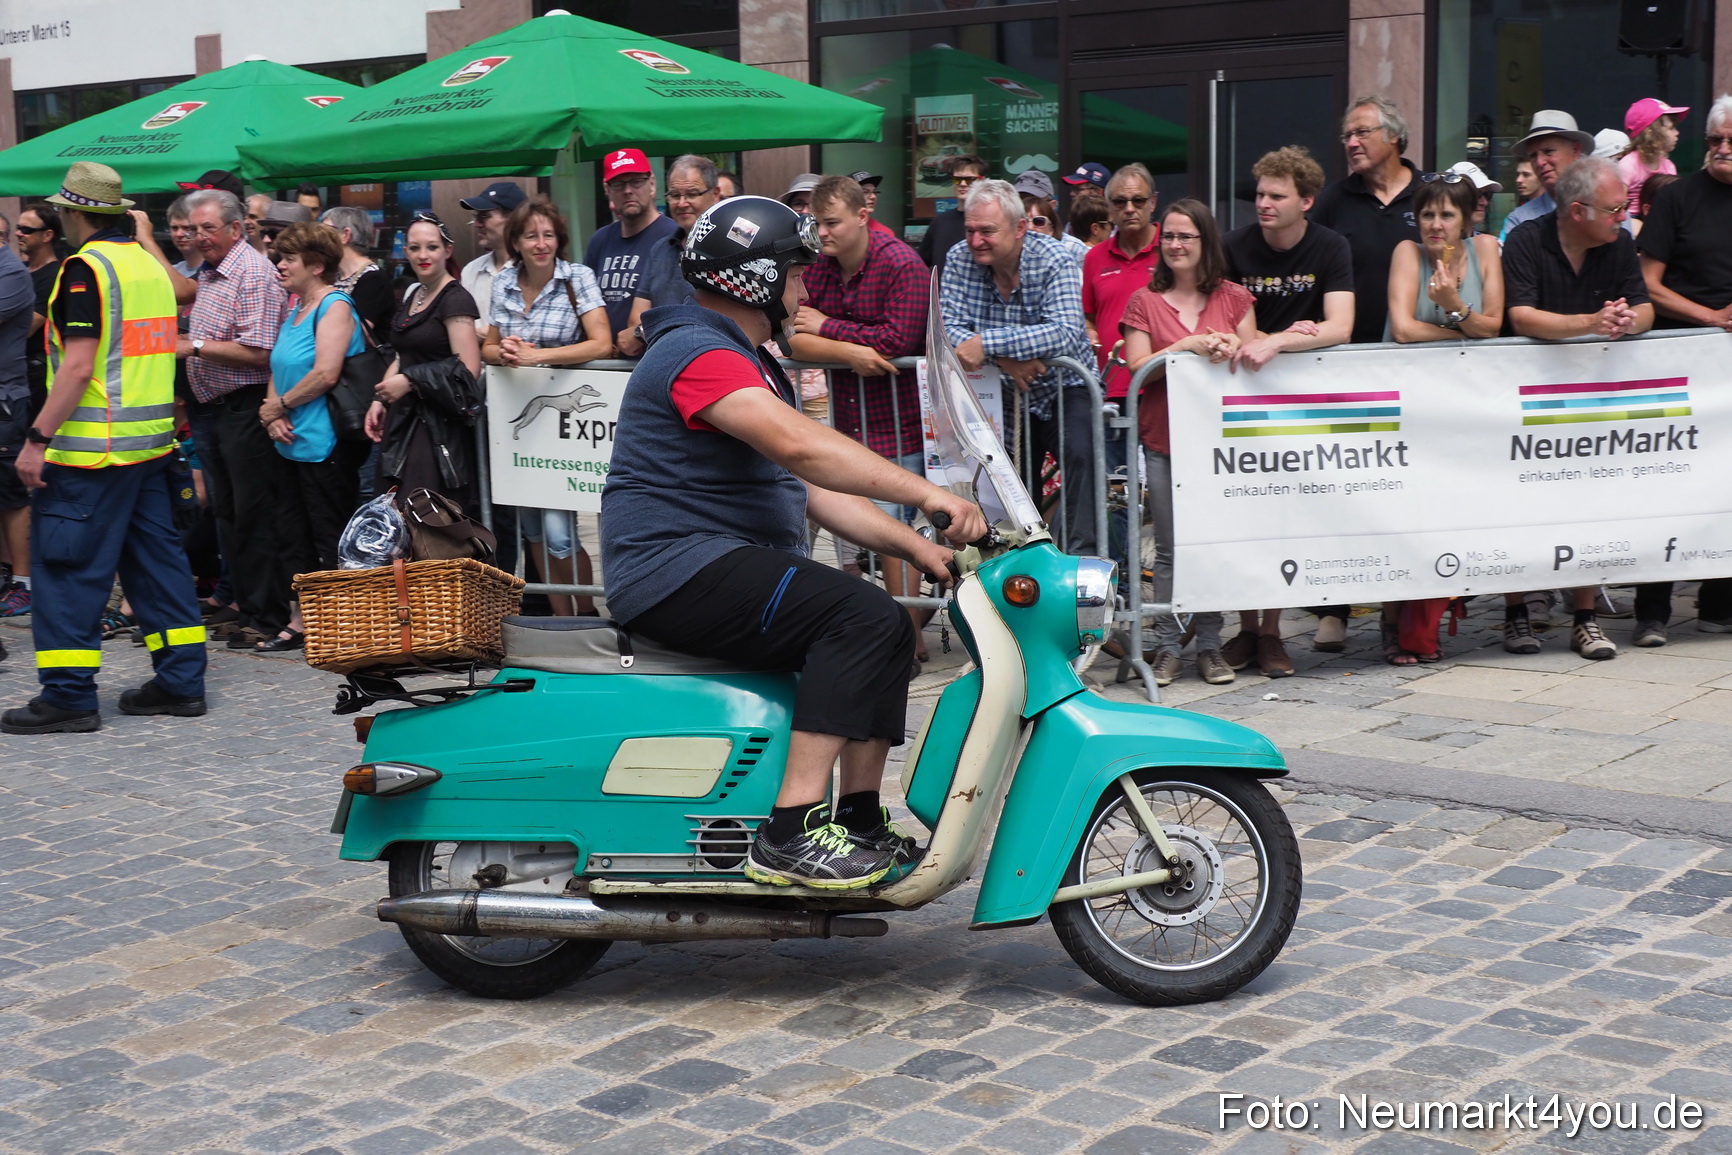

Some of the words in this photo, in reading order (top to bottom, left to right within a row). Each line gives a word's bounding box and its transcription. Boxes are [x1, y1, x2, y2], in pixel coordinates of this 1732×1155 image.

[31, 24, 58, 41] Markt
[60, 20, 71, 37] 15
[387, 88, 494, 107] Neumarkter
[645, 86, 787, 99] Lammsbräu
[347, 97, 494, 123] Lammsbräu
[920, 115, 969, 133] OLDTIMER
[92, 132, 183, 144] Neumarkter
[55, 142, 179, 158] Lammsbräu
[602, 255, 640, 271] DEER
[597, 272, 640, 289] ODGE
[559, 412, 617, 449] Expr
[1510, 424, 1699, 461] NeuerMarkt
[513, 453, 610, 476] Interessenge
[1213, 439, 1409, 475] NeuerMarkt
[1519, 468, 1581, 482] einkaufen
[1589, 465, 1624, 479] leben
[1632, 461, 1691, 479] genießen
[1224, 483, 1290, 498] einkaufen
[1299, 482, 1336, 494] leben
[1344, 478, 1404, 495] genießen
[1580, 543, 1605, 555] über
[1608, 541, 1631, 553] 500
[1305, 556, 1382, 570] Dammstraße
[1384, 555, 1391, 566] 1
[1465, 565, 1502, 577] 10-20
[1504, 565, 1526, 574] Uhr
[1578, 557, 1637, 570] Parkplätze
[1305, 573, 1364, 586] Neumarkt
[1366, 572, 1373, 582] i.
[1375, 571, 1385, 582] d.
[1388, 569, 1413, 581] OPf.
